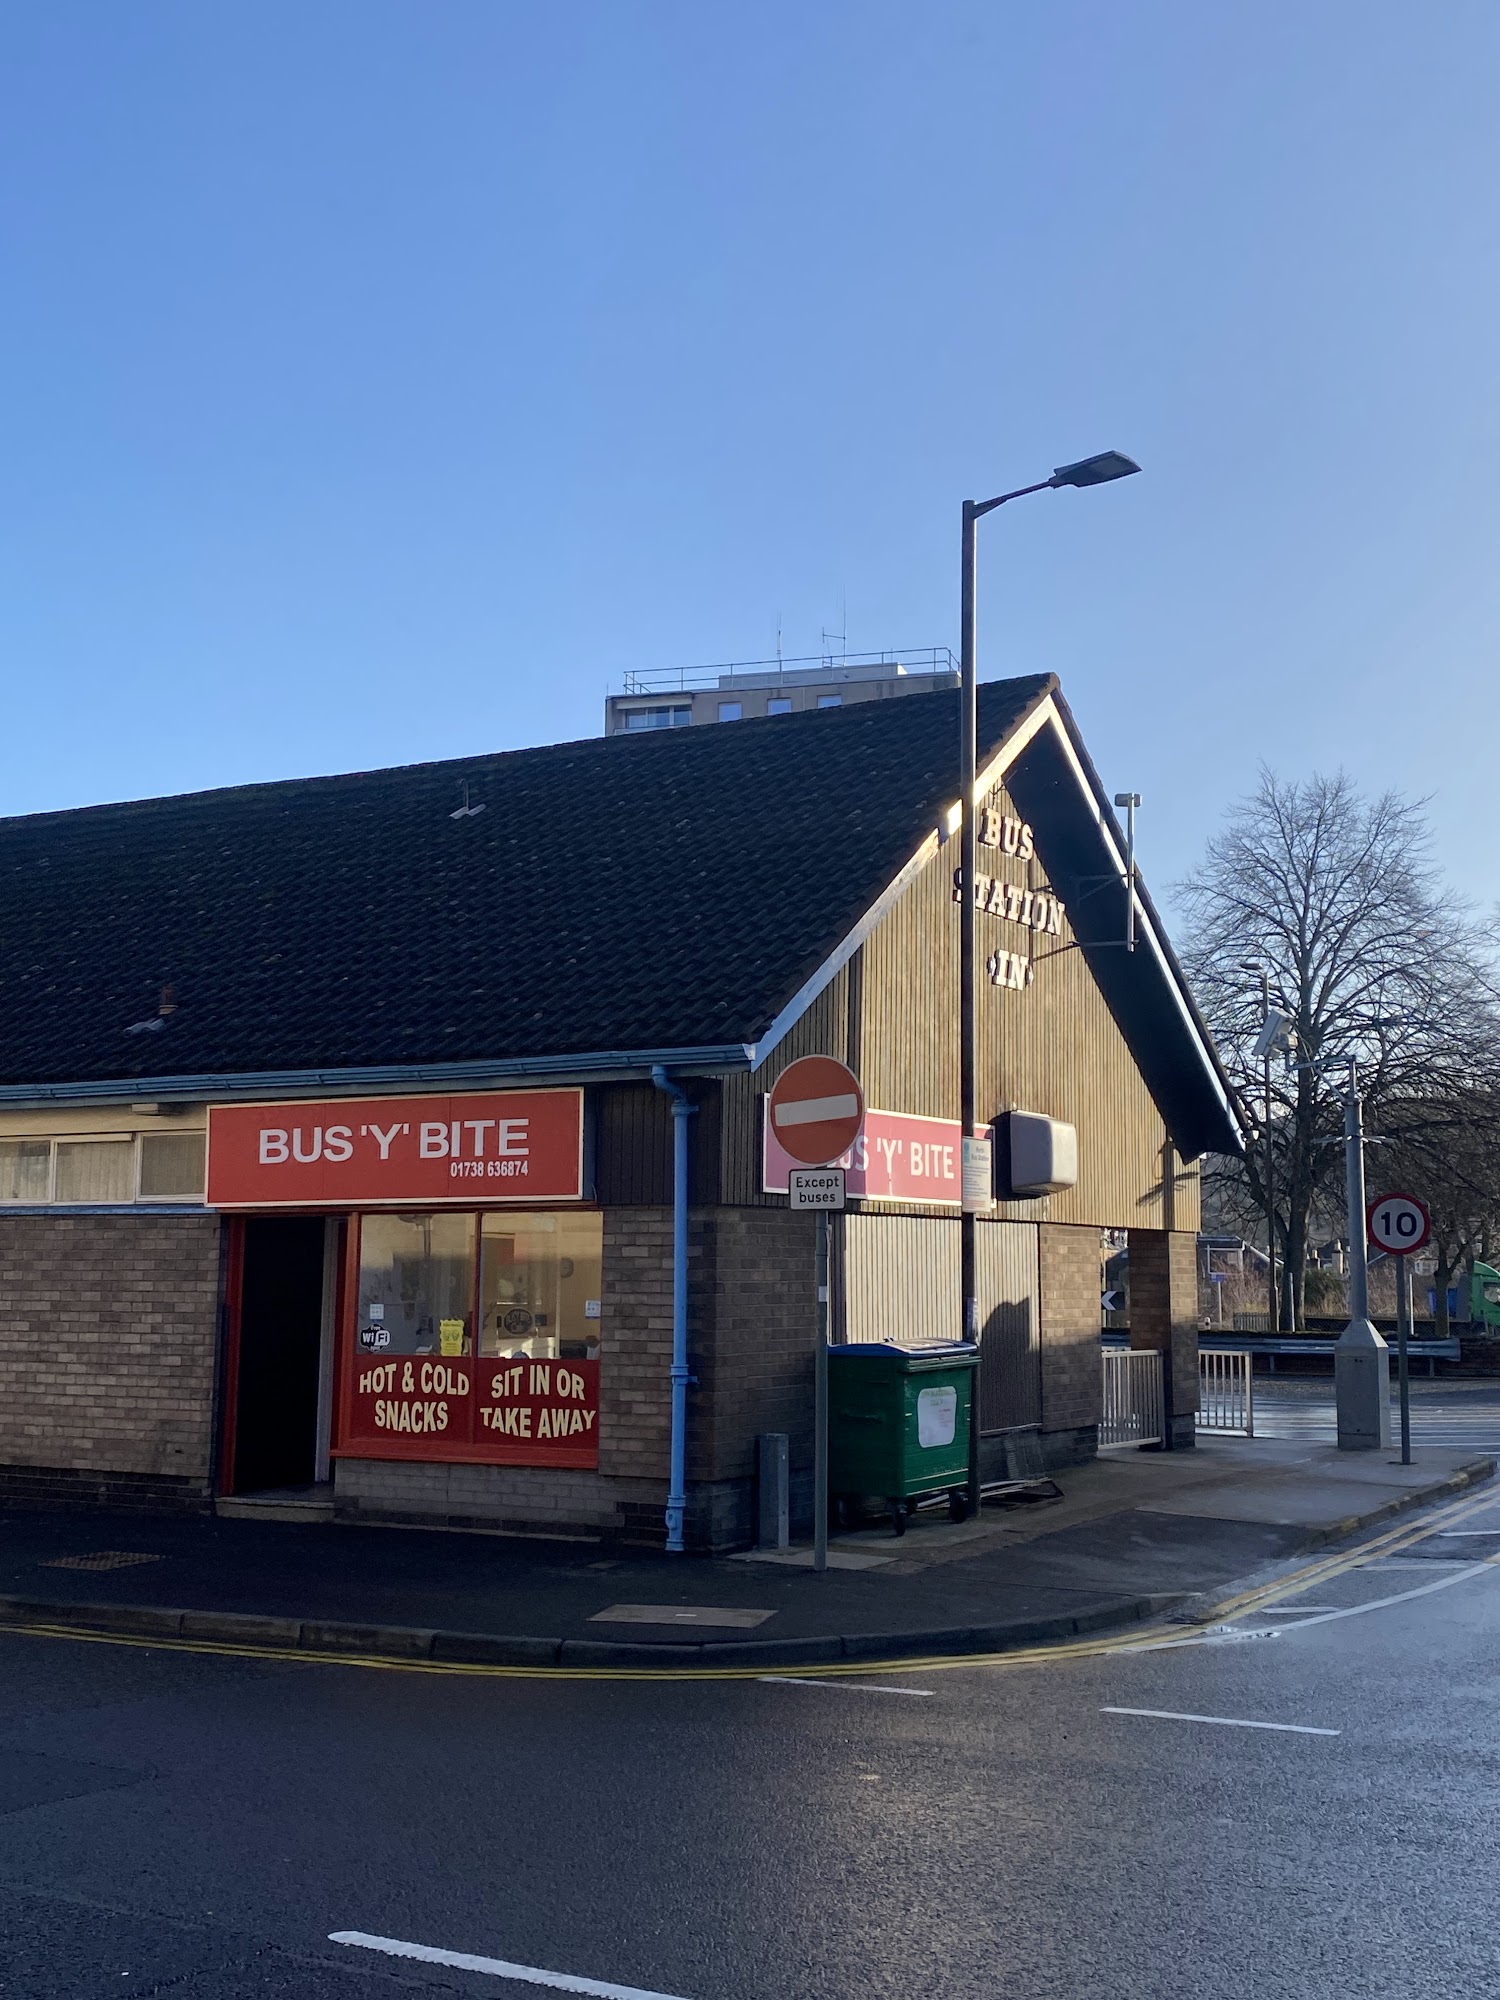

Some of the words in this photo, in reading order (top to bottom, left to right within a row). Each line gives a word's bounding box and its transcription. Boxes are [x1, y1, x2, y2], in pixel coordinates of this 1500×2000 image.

[979, 808, 1034, 862] BUS
[259, 1125, 354, 1165] BUS
[360, 1122, 410, 1160] 'Y'
[419, 1118, 530, 1160] BITE
[450, 1160, 484, 1178] 01738
[487, 1160, 529, 1178] 636874
[910, 1142, 954, 1179] BITE
[796, 1175, 839, 1189] Except
[799, 1191, 836, 1203] buses
[1381, 1212, 1417, 1237] 10
[359, 1363, 398, 1394] HOT
[402, 1361, 415, 1394] &
[420, 1361, 470, 1396] COLD
[491, 1366, 524, 1399] SIT
[529, 1364, 551, 1396] IN
[556, 1368, 586, 1401] OR
[374, 1399, 449, 1434] SNACKS
[480, 1407, 532, 1438] TAKE
[536, 1408, 597, 1439] AWAY
